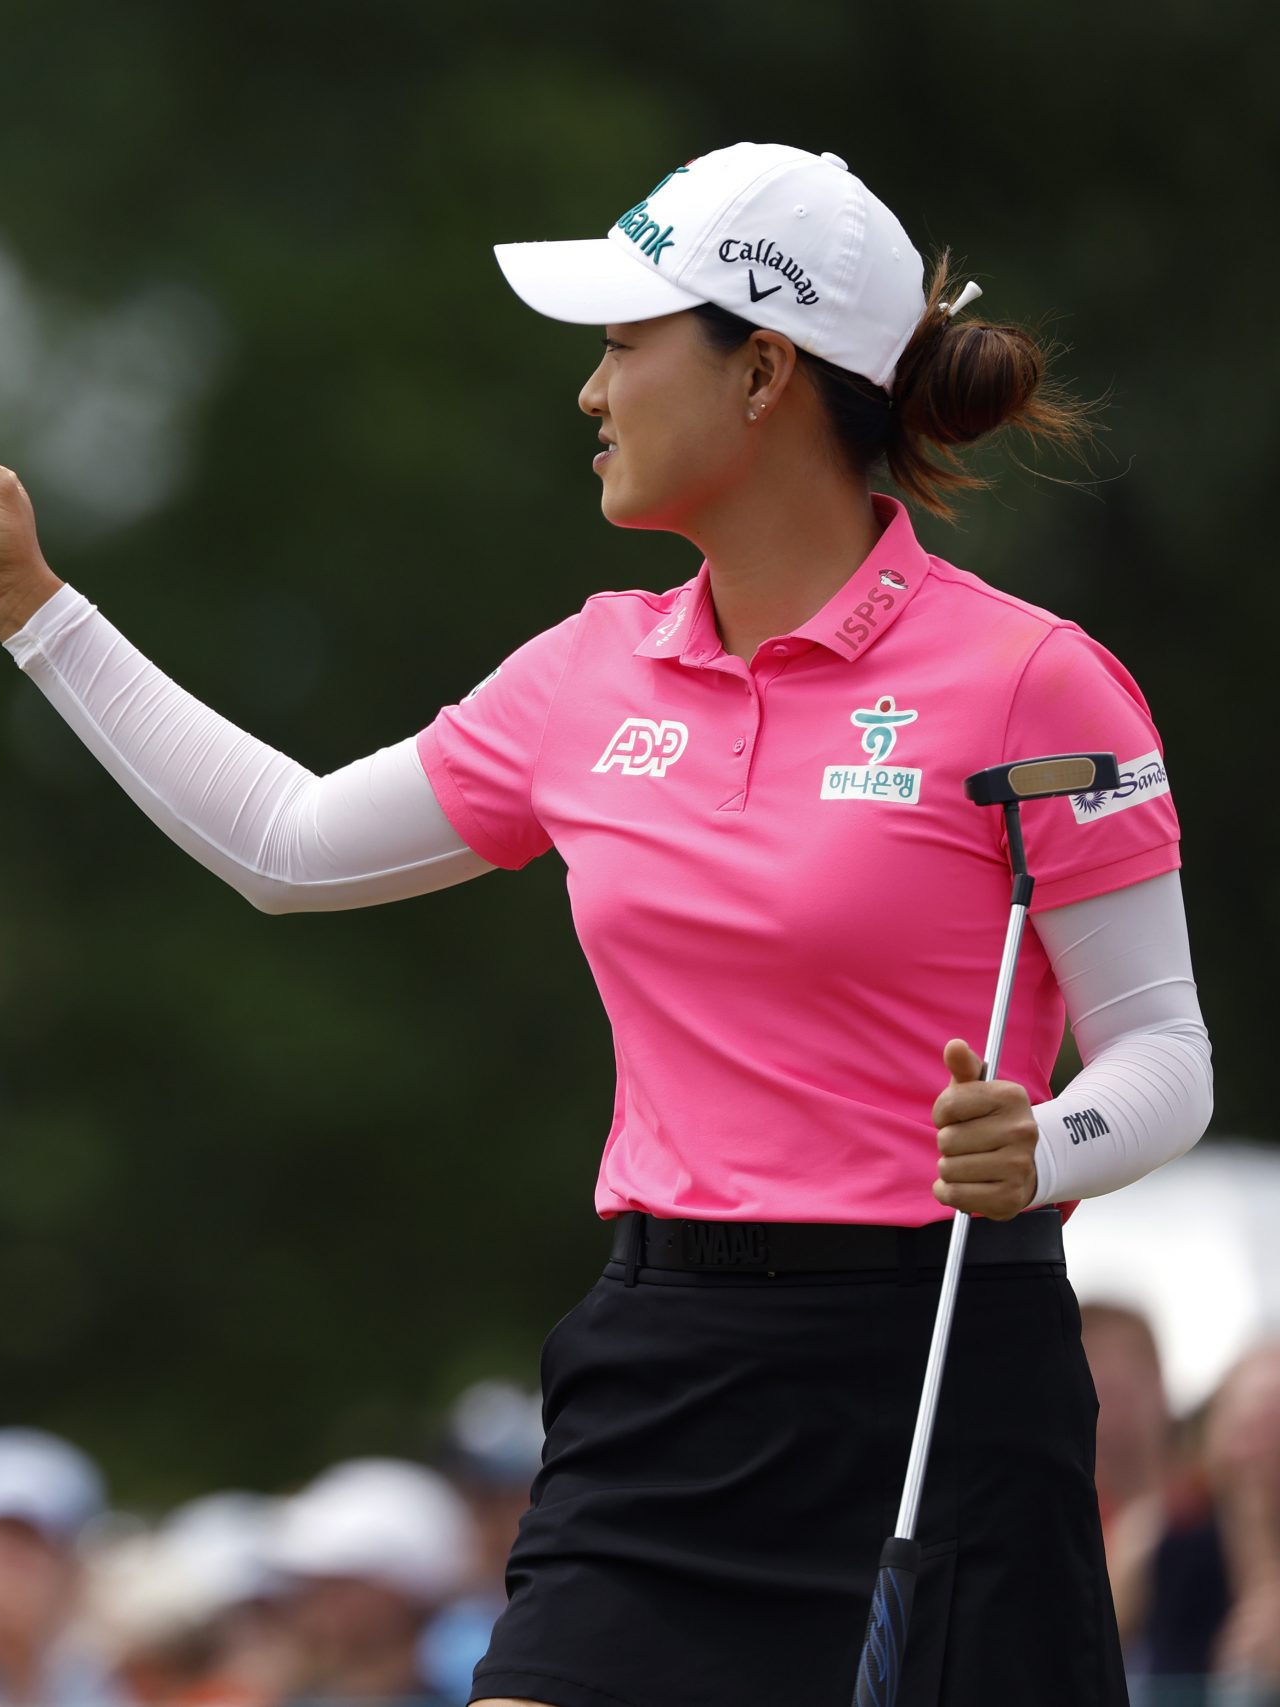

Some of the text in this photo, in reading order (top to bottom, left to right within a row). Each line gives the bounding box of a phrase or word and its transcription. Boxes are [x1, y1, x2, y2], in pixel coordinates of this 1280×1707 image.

[616, 200, 675, 265] Bank
[719, 238, 819, 305] Callaway
[835, 587, 895, 651] ISPS
[591, 717, 689, 777] ADP
[828, 770, 916, 799] 하나은행
[1112, 761, 1167, 800] Sands
[1062, 1108, 1110, 1145] WAAC
[689, 1223, 768, 1265] WAAC
